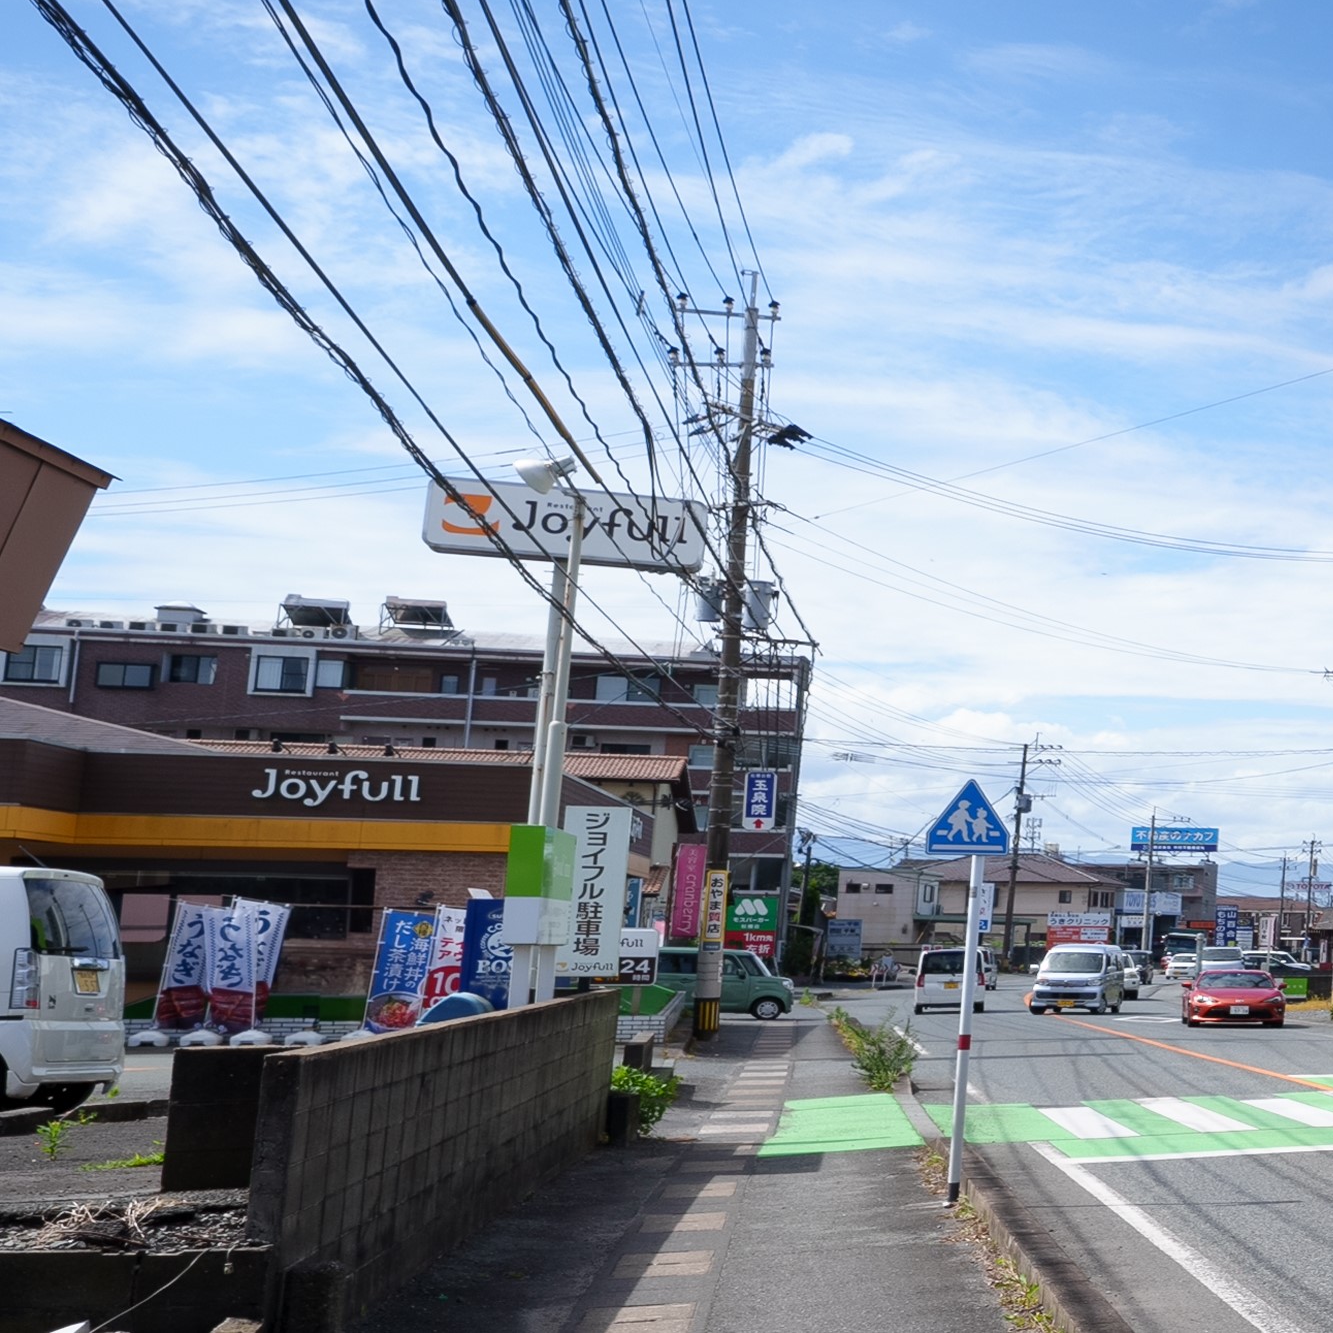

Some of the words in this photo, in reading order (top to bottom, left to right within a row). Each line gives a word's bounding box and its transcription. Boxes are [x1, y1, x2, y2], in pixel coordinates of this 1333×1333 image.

[252, 768, 421, 807] Joyfull
[285, 769, 340, 777] Restaurant
[573, 813, 610, 956] ジョイフル駐車場
[677, 874, 698, 934] cranberry
[707, 878, 724, 934] おやま質店
[172, 913, 204, 985] うなぎ
[383, 920, 413, 991] だし茶漬け
[404, 938, 430, 988] 海鮮丼の
[571, 962, 614, 972] Joyfull
[620, 959, 650, 973] 24
